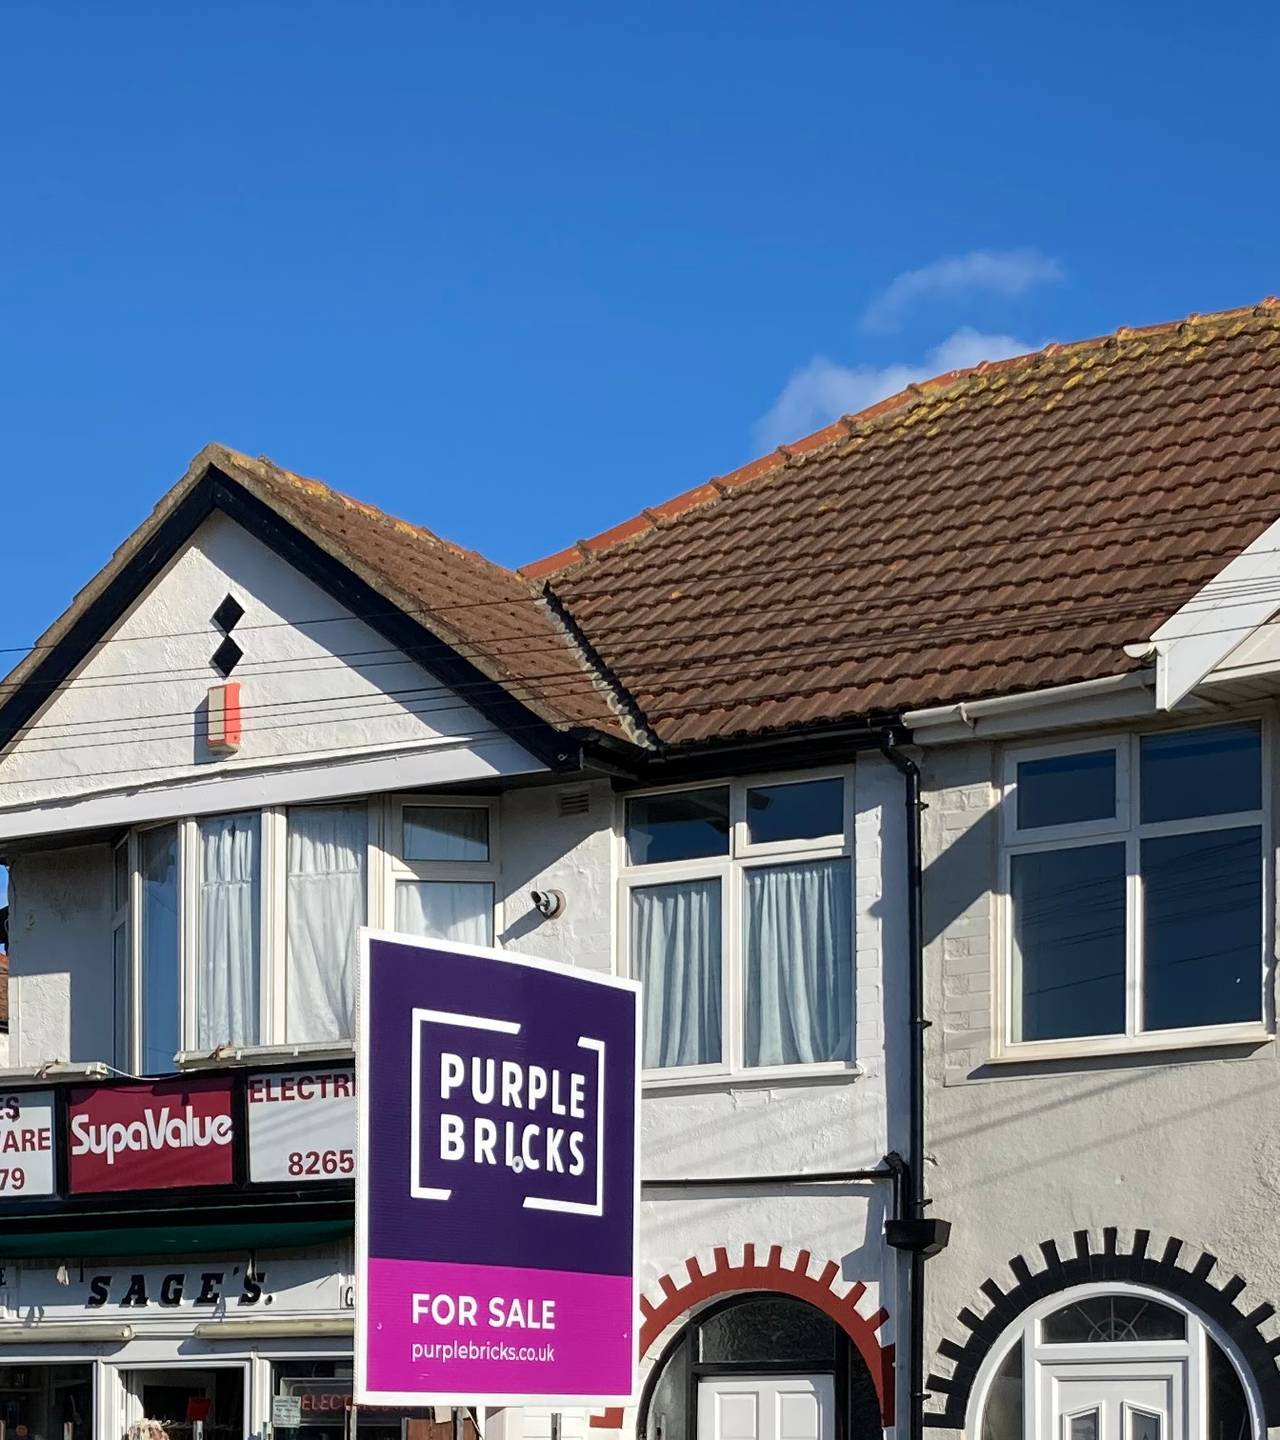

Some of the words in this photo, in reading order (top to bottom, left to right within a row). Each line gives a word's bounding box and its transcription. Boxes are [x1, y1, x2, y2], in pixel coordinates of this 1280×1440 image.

[249, 1073, 355, 1104] ELECTRI
[440, 1052, 585, 1119] PURPLE
[71, 1105, 233, 1165] SupaValue
[440, 1113, 585, 1176] BRICKS
[288, 1149, 355, 1176] 8265
[412, 1292, 478, 1327] FOR
[488, 1296, 556, 1330] SALE
[412, 1340, 555, 1364] purplebricks.co.uk
